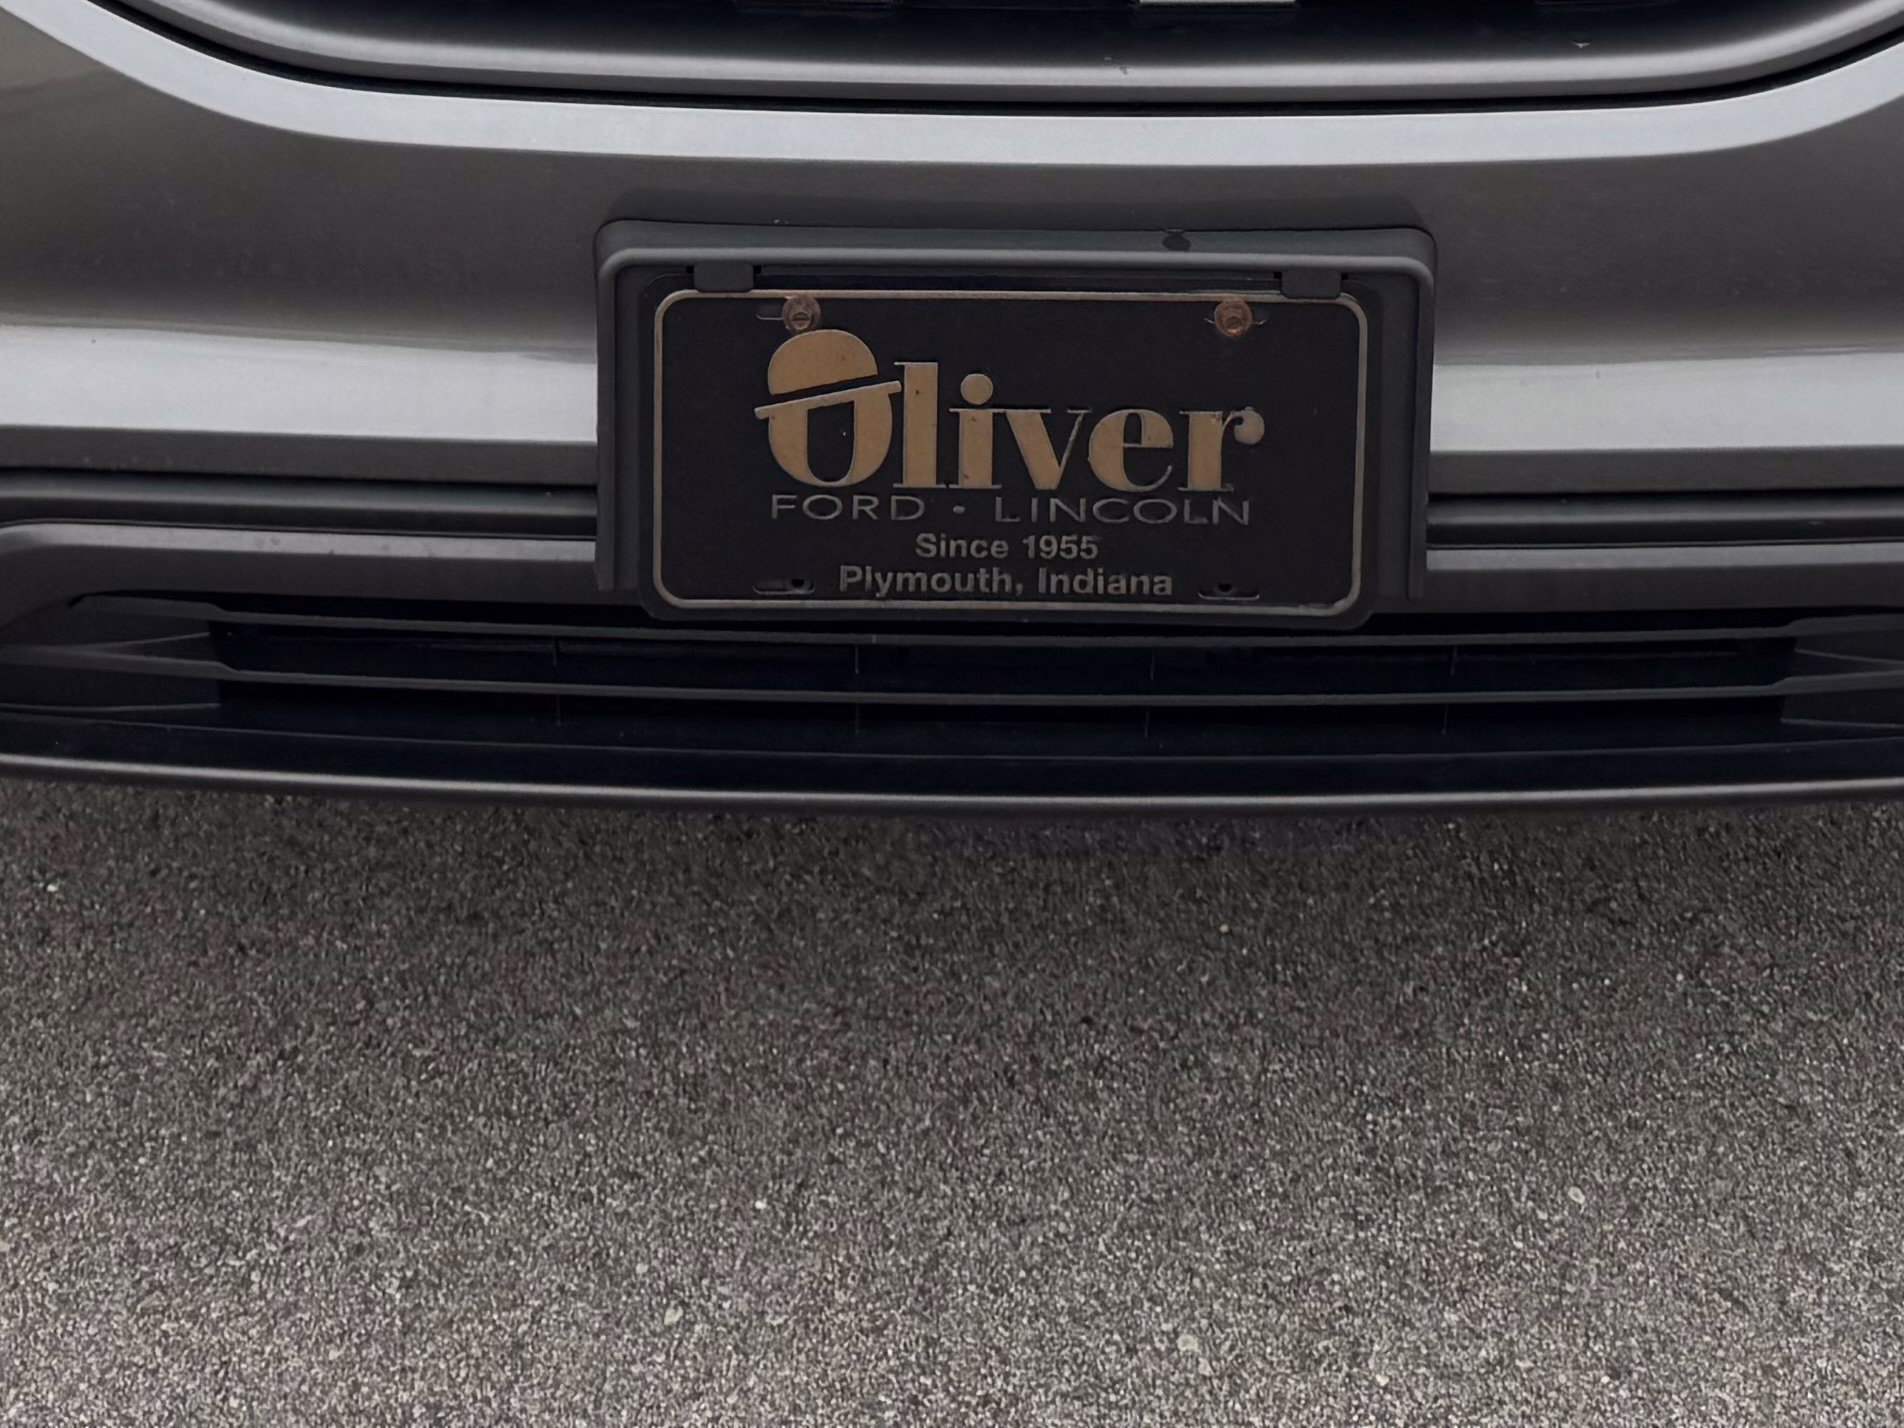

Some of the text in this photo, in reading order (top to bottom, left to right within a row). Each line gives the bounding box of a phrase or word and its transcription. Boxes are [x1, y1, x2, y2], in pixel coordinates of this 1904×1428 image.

[754, 329, 1266, 493] Oliver
[770, 493, 1251, 526] FORD LINCOLN
[915, 532, 1100, 561] Since 1955
[838, 565, 1174, 598] Plymouth, Indiana
